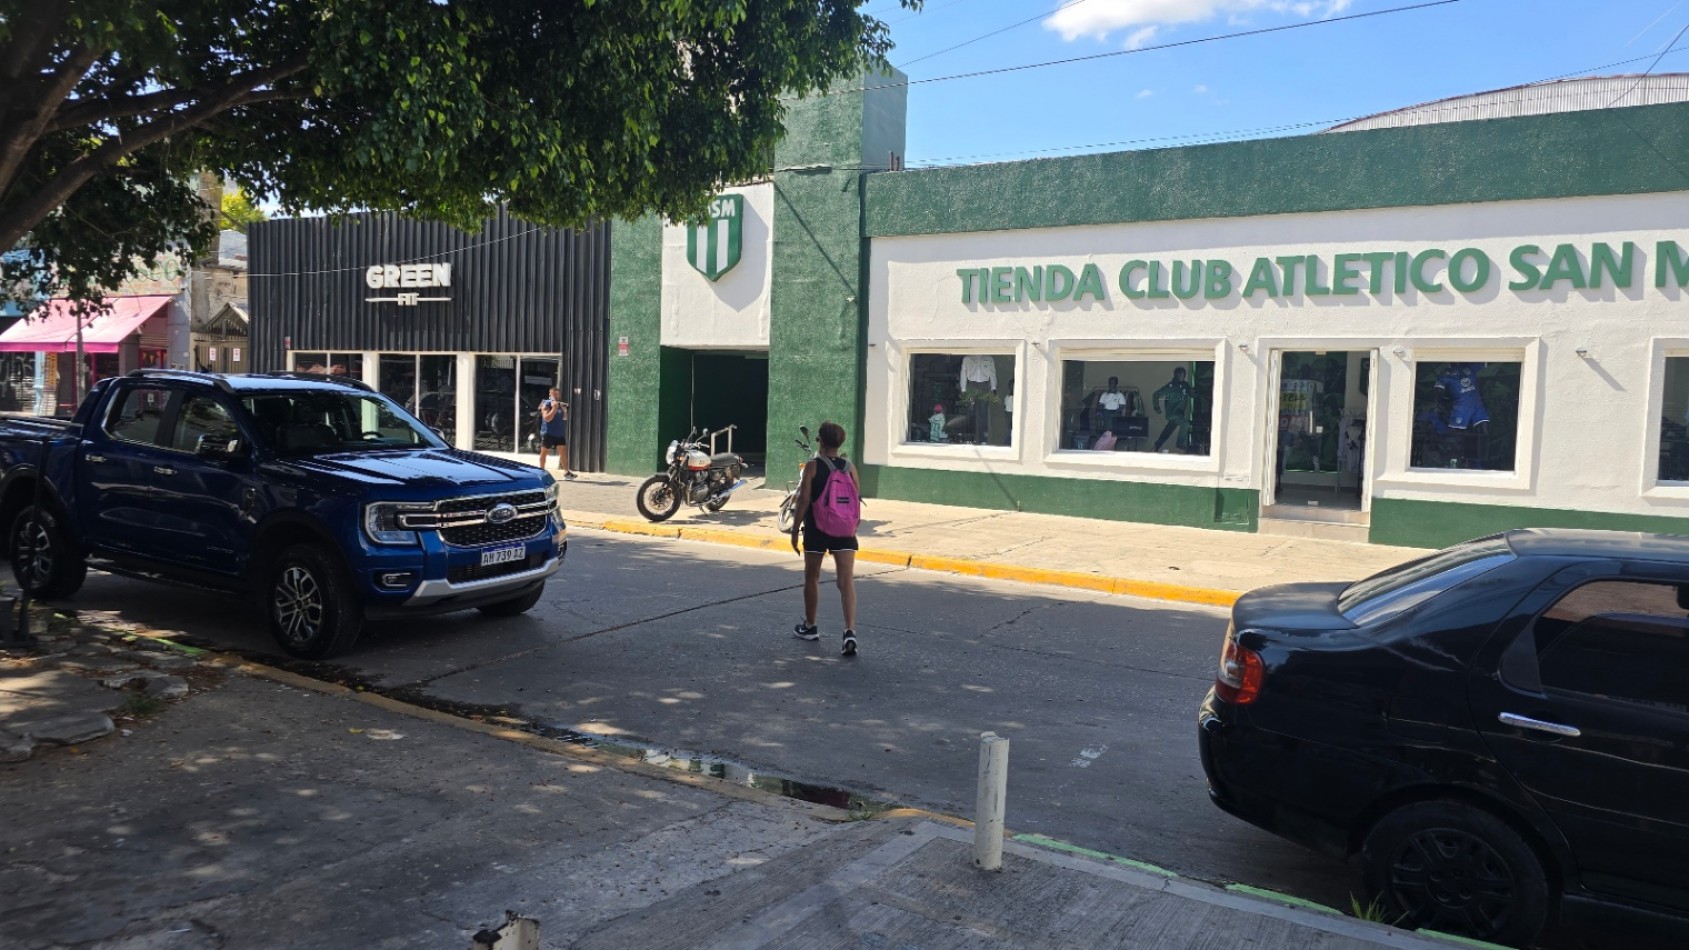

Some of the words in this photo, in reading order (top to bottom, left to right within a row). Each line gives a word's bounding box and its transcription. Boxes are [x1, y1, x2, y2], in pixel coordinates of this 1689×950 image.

[707, 198, 736, 218] SM
[366, 262, 452, 289] GREEN
[956, 263, 1106, 303] TIENDA
[1118, 259, 1232, 300] CLUB
[1242, 247, 1490, 298] ATLETICO
[1508, 241, 1634, 291] SAN
[397, 292, 420, 306] FIT
[483, 552, 494, 564] AH
[497, 550, 512, 561] 739
